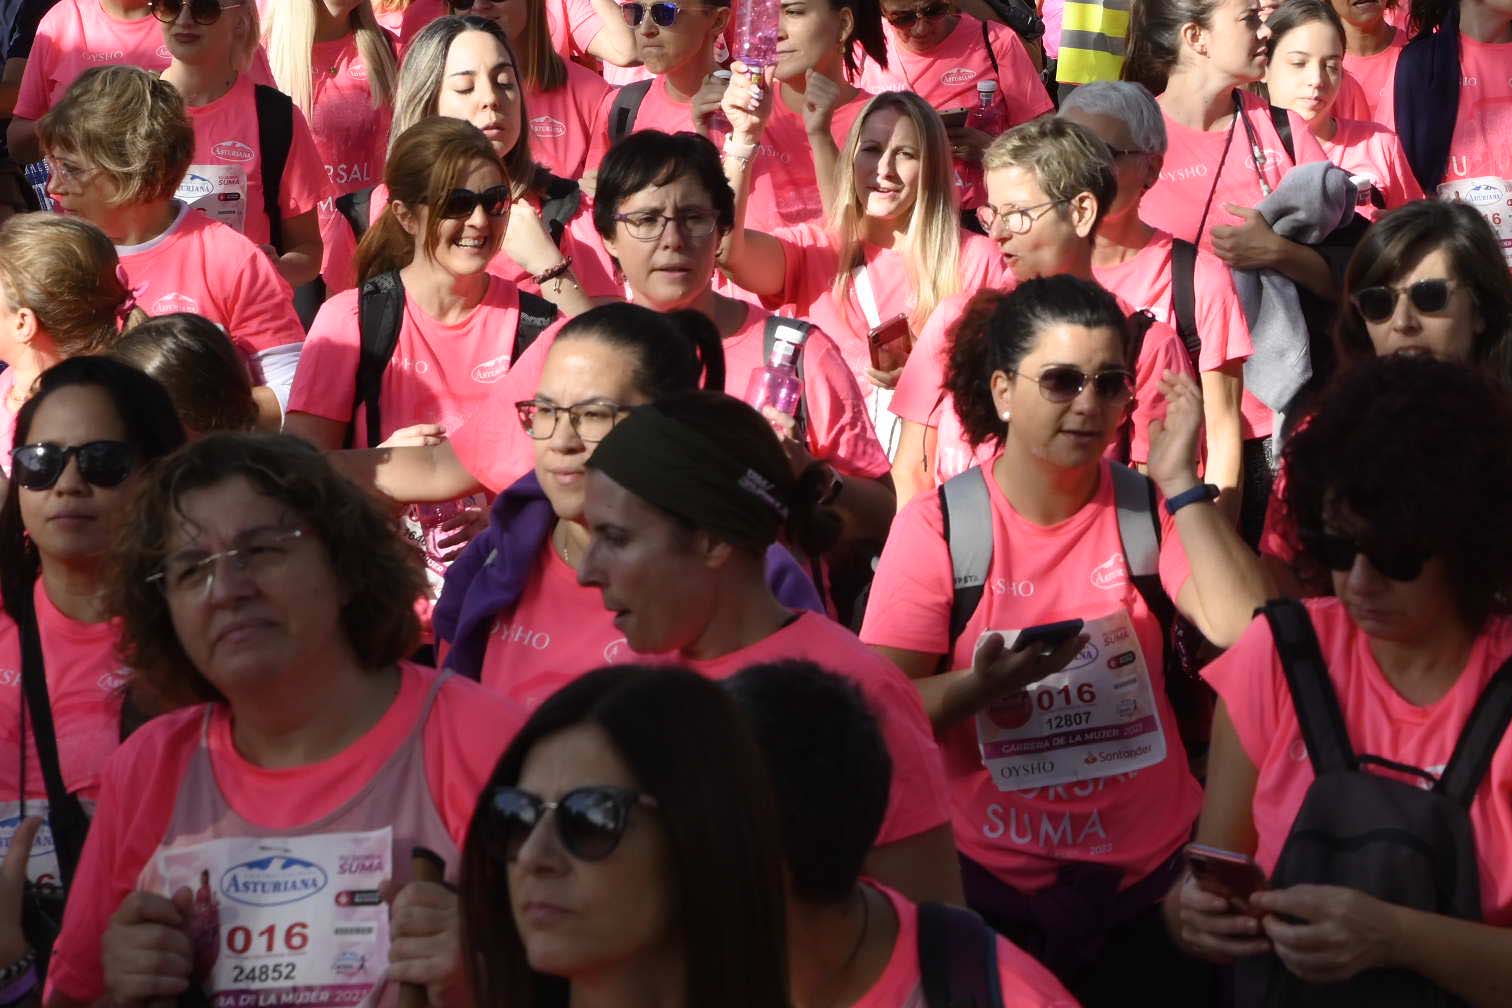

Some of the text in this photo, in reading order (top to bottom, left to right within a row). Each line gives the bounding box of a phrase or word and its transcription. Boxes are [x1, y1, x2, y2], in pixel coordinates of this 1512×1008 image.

[1036, 682, 1097, 713] 016
[1046, 711, 1092, 730] 12807
[1099, 743, 1153, 763] Santander
[1000, 760, 1055, 779] OYSHO
[982, 803, 1107, 848] SUMA
[339, 860, 384, 874] SUMA
[225, 869, 318, 893] ASTURIANA
[226, 922, 309, 954] 016
[232, 962, 297, 983] 24852
